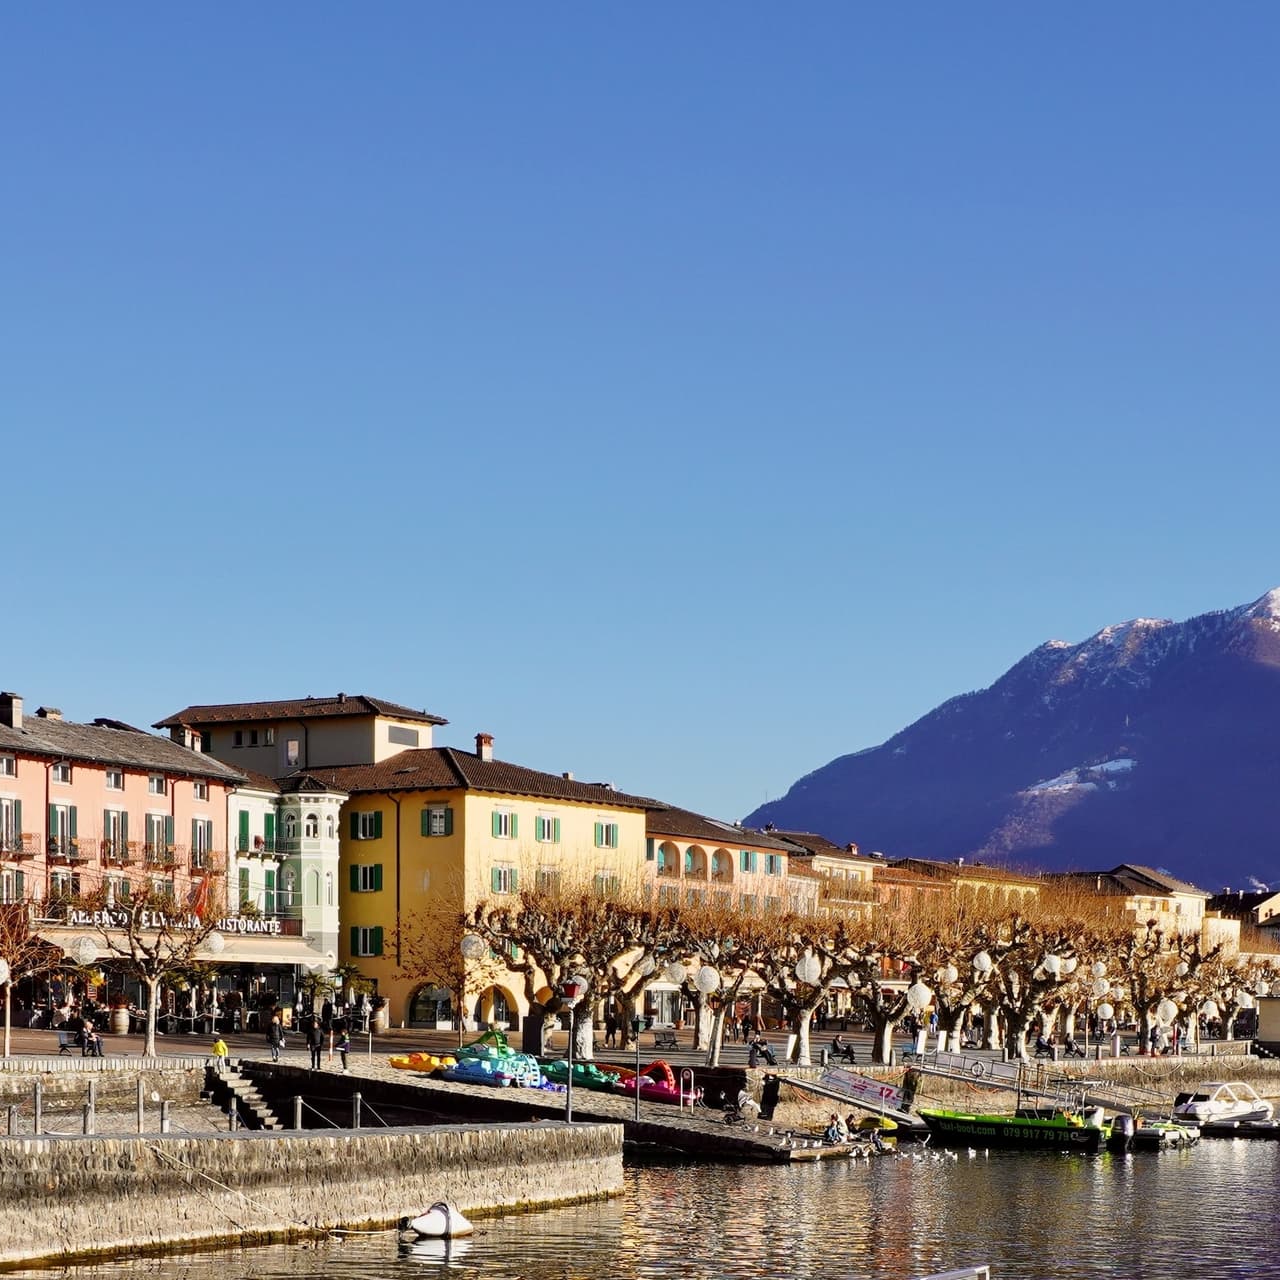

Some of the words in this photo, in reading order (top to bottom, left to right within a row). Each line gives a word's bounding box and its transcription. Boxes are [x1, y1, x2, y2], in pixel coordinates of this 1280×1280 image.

[216, 918, 281, 933] RISTORANTE
[1003, 1127, 1020, 1138] 079
[1023, 1128, 1039, 1139] 917
[1043, 1130, 1055, 1140] 79
[1057, 1131, 1070, 1141] 79
